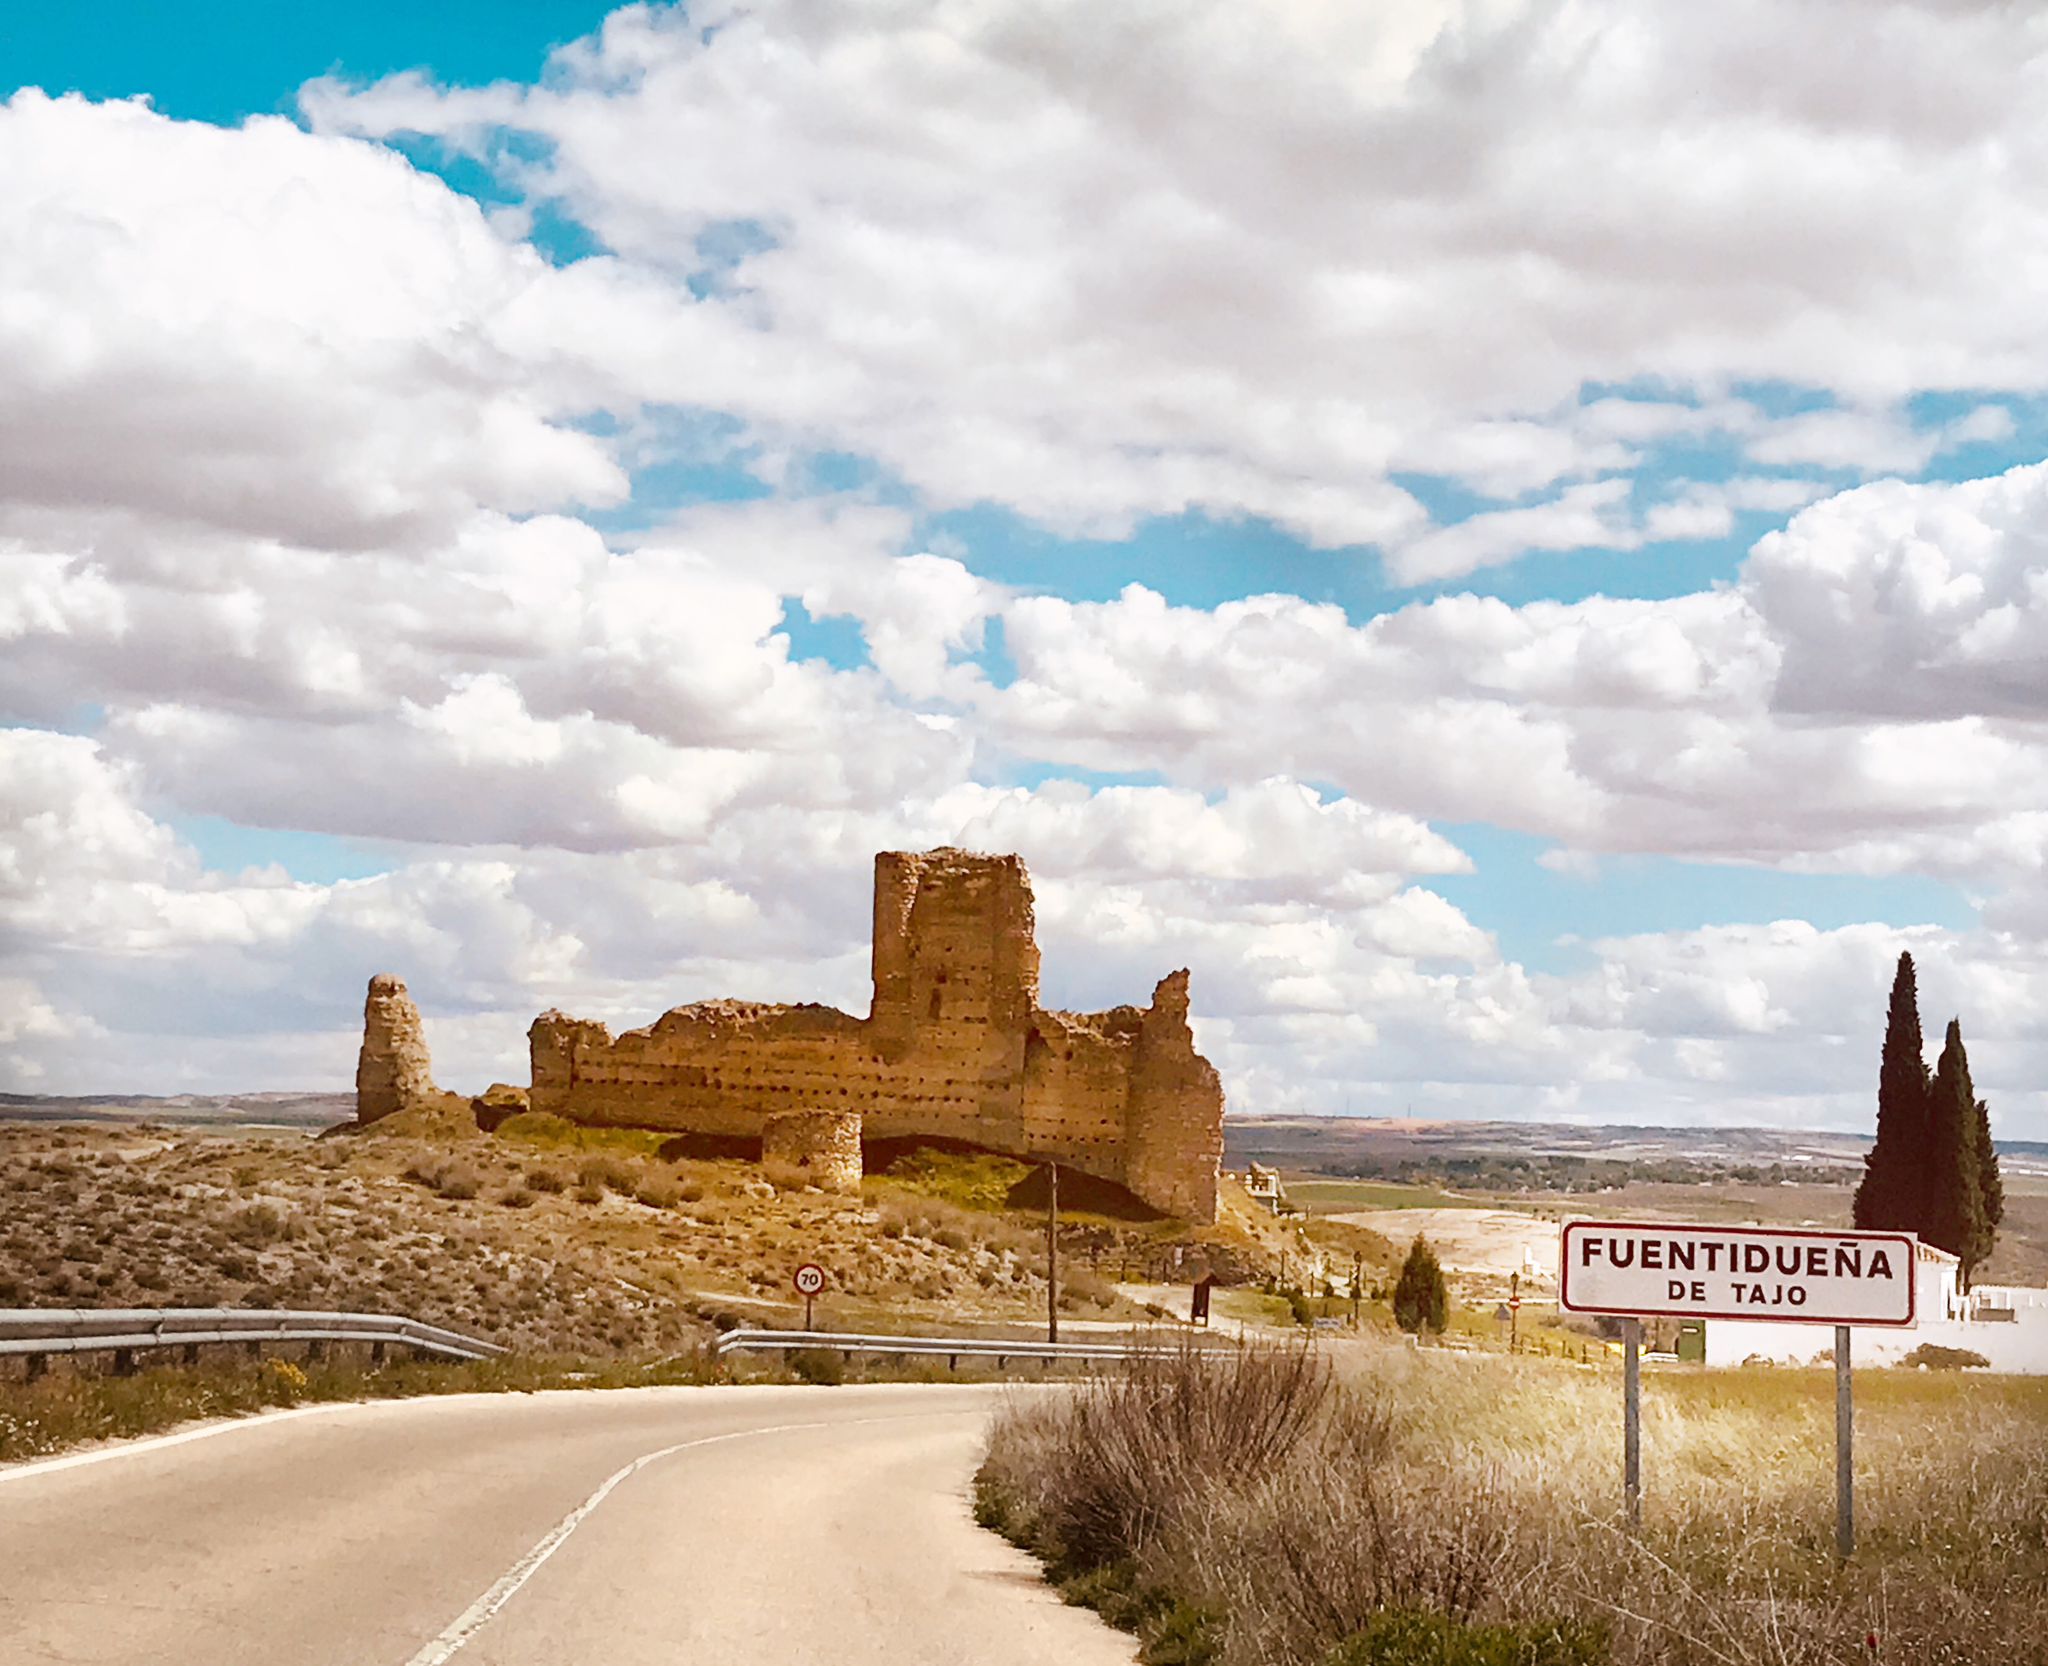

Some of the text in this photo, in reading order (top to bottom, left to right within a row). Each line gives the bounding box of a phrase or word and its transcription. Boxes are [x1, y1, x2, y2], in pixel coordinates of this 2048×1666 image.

[1582, 1237, 1893, 1280] FUENTIDUEÑA
[801, 1273, 819, 1286] 70
[1668, 1280, 1807, 1306] DE TAJO
